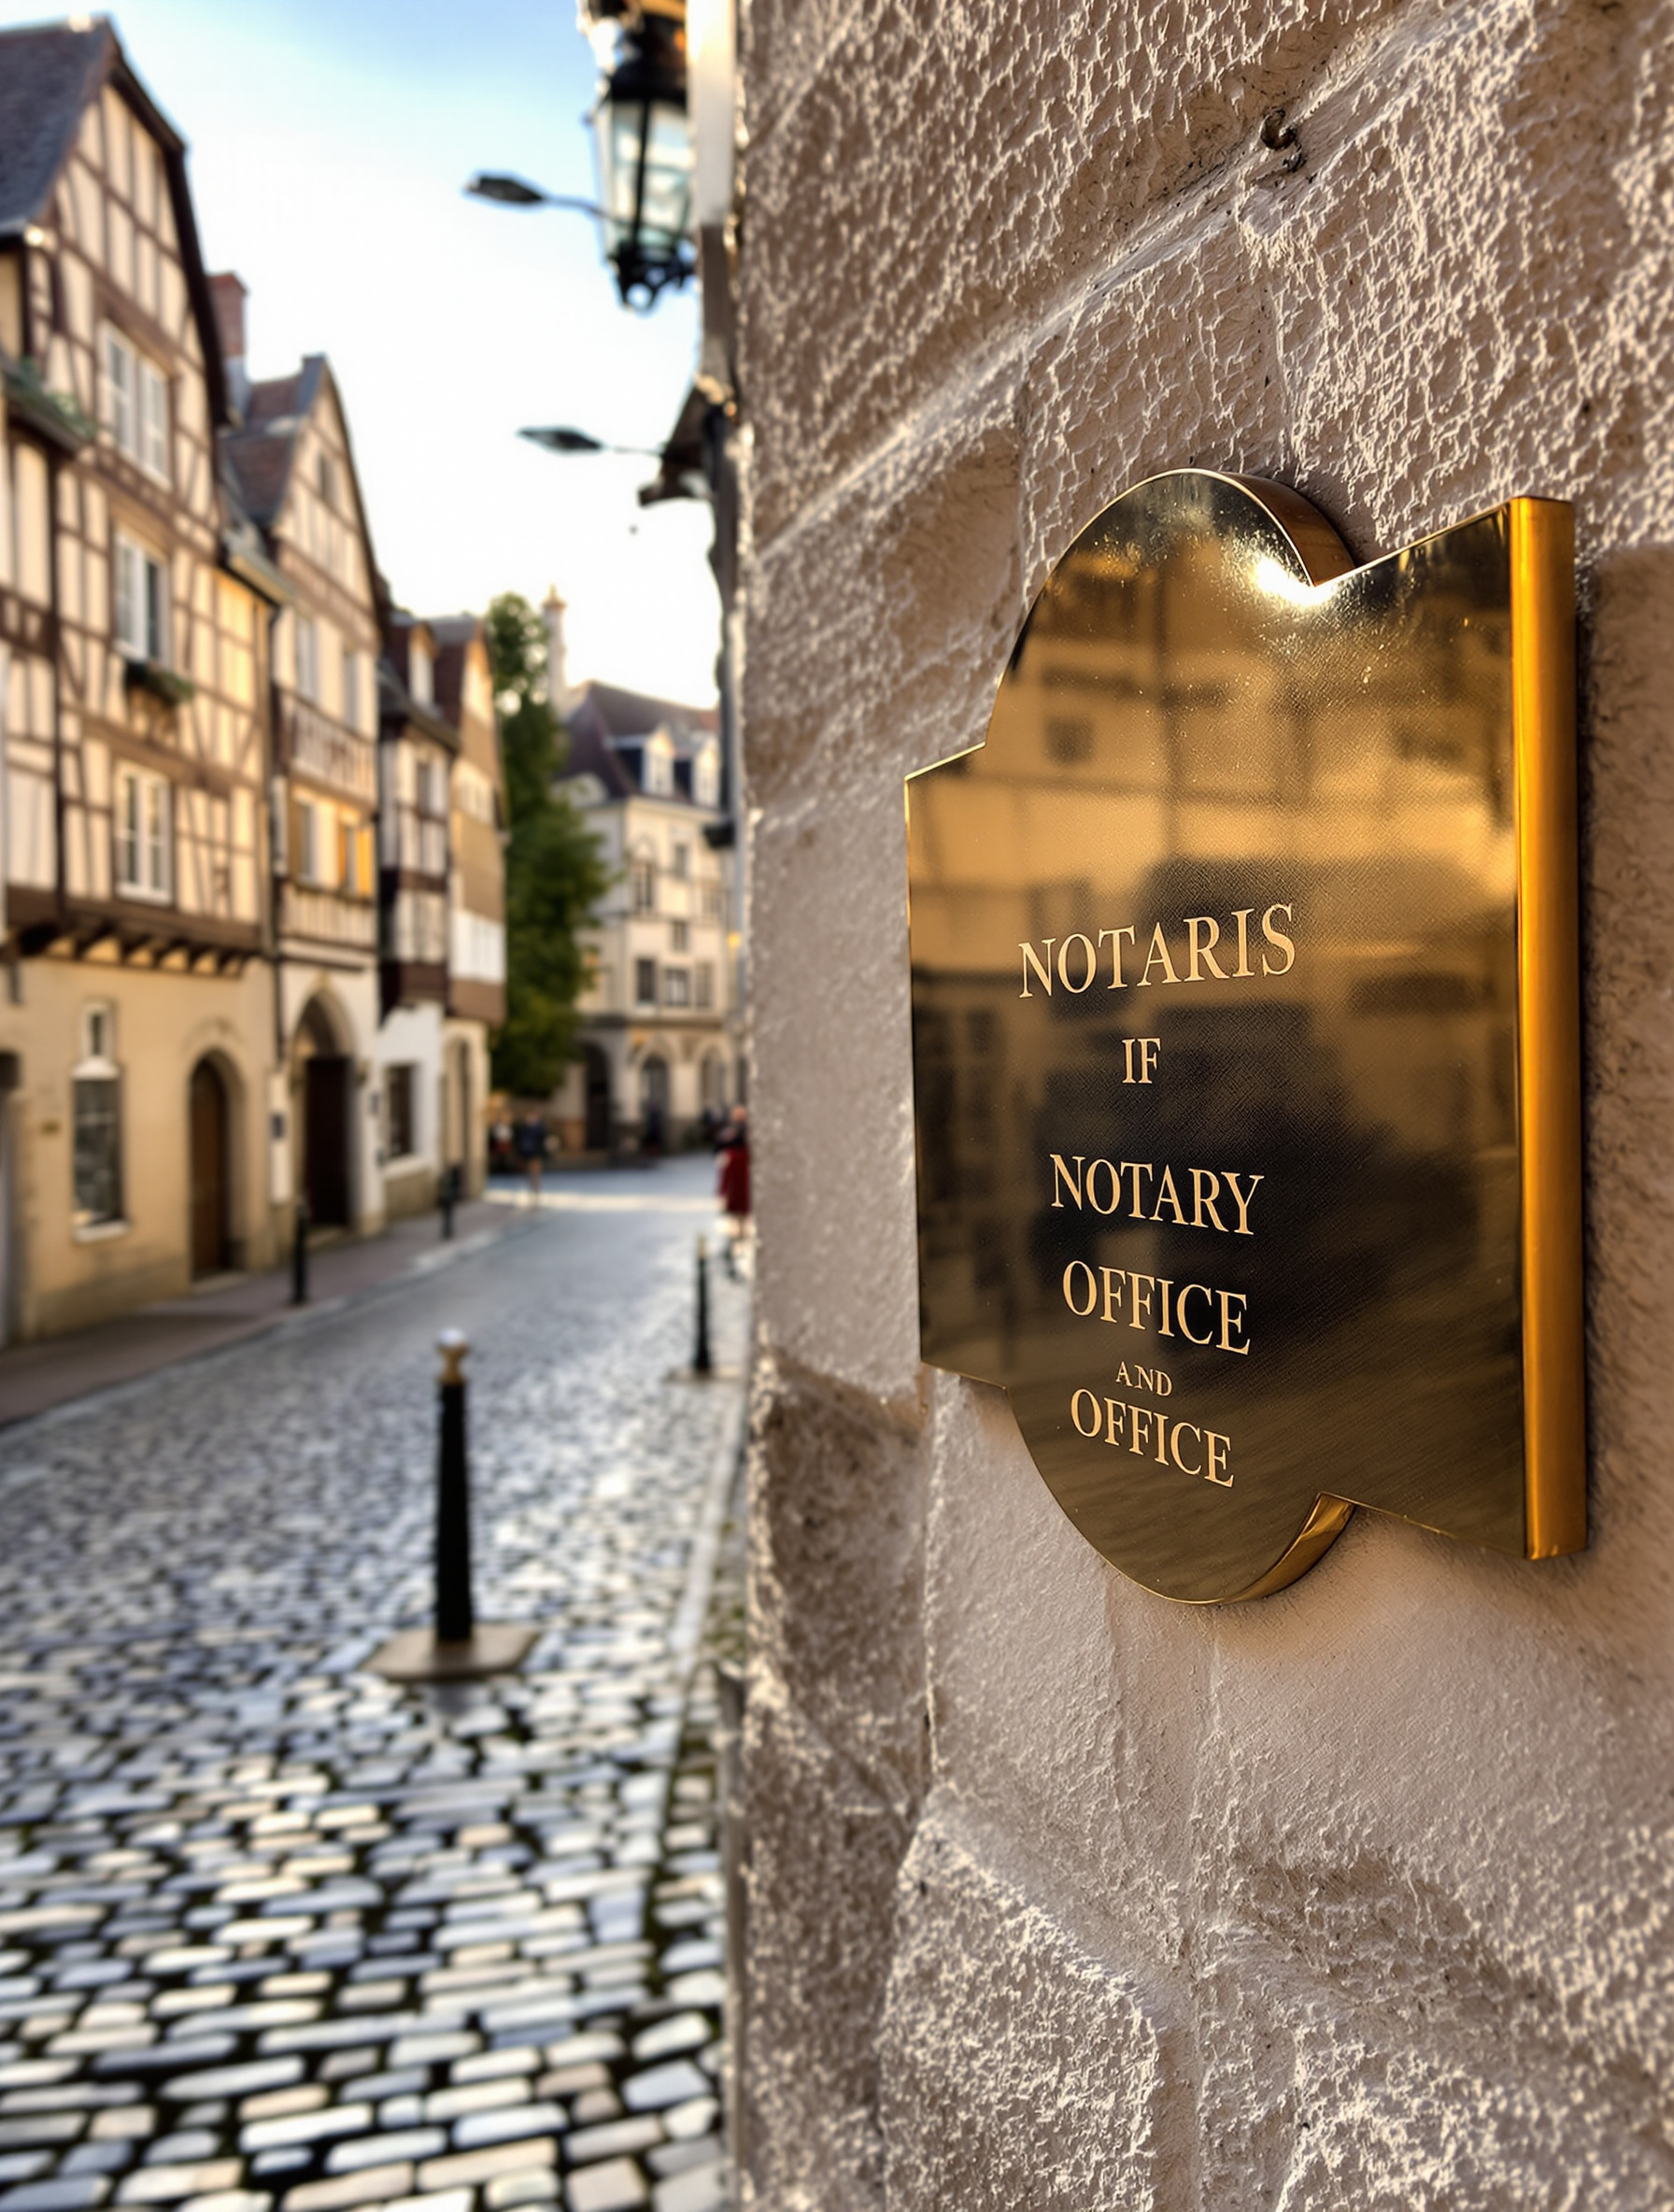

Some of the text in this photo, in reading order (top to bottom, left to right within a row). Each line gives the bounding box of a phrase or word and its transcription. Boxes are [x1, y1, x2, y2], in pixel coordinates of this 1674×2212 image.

[1018, 902, 1297, 1000] NOTARIS
[1121, 1037, 1162, 1085] IF
[1049, 1153, 1265, 1235] NOTARY
[1062, 1260, 1251, 1355] OFFICE
[1115, 1361, 1173, 1397] AND
[1071, 1388, 1235, 1488] OFFICE
